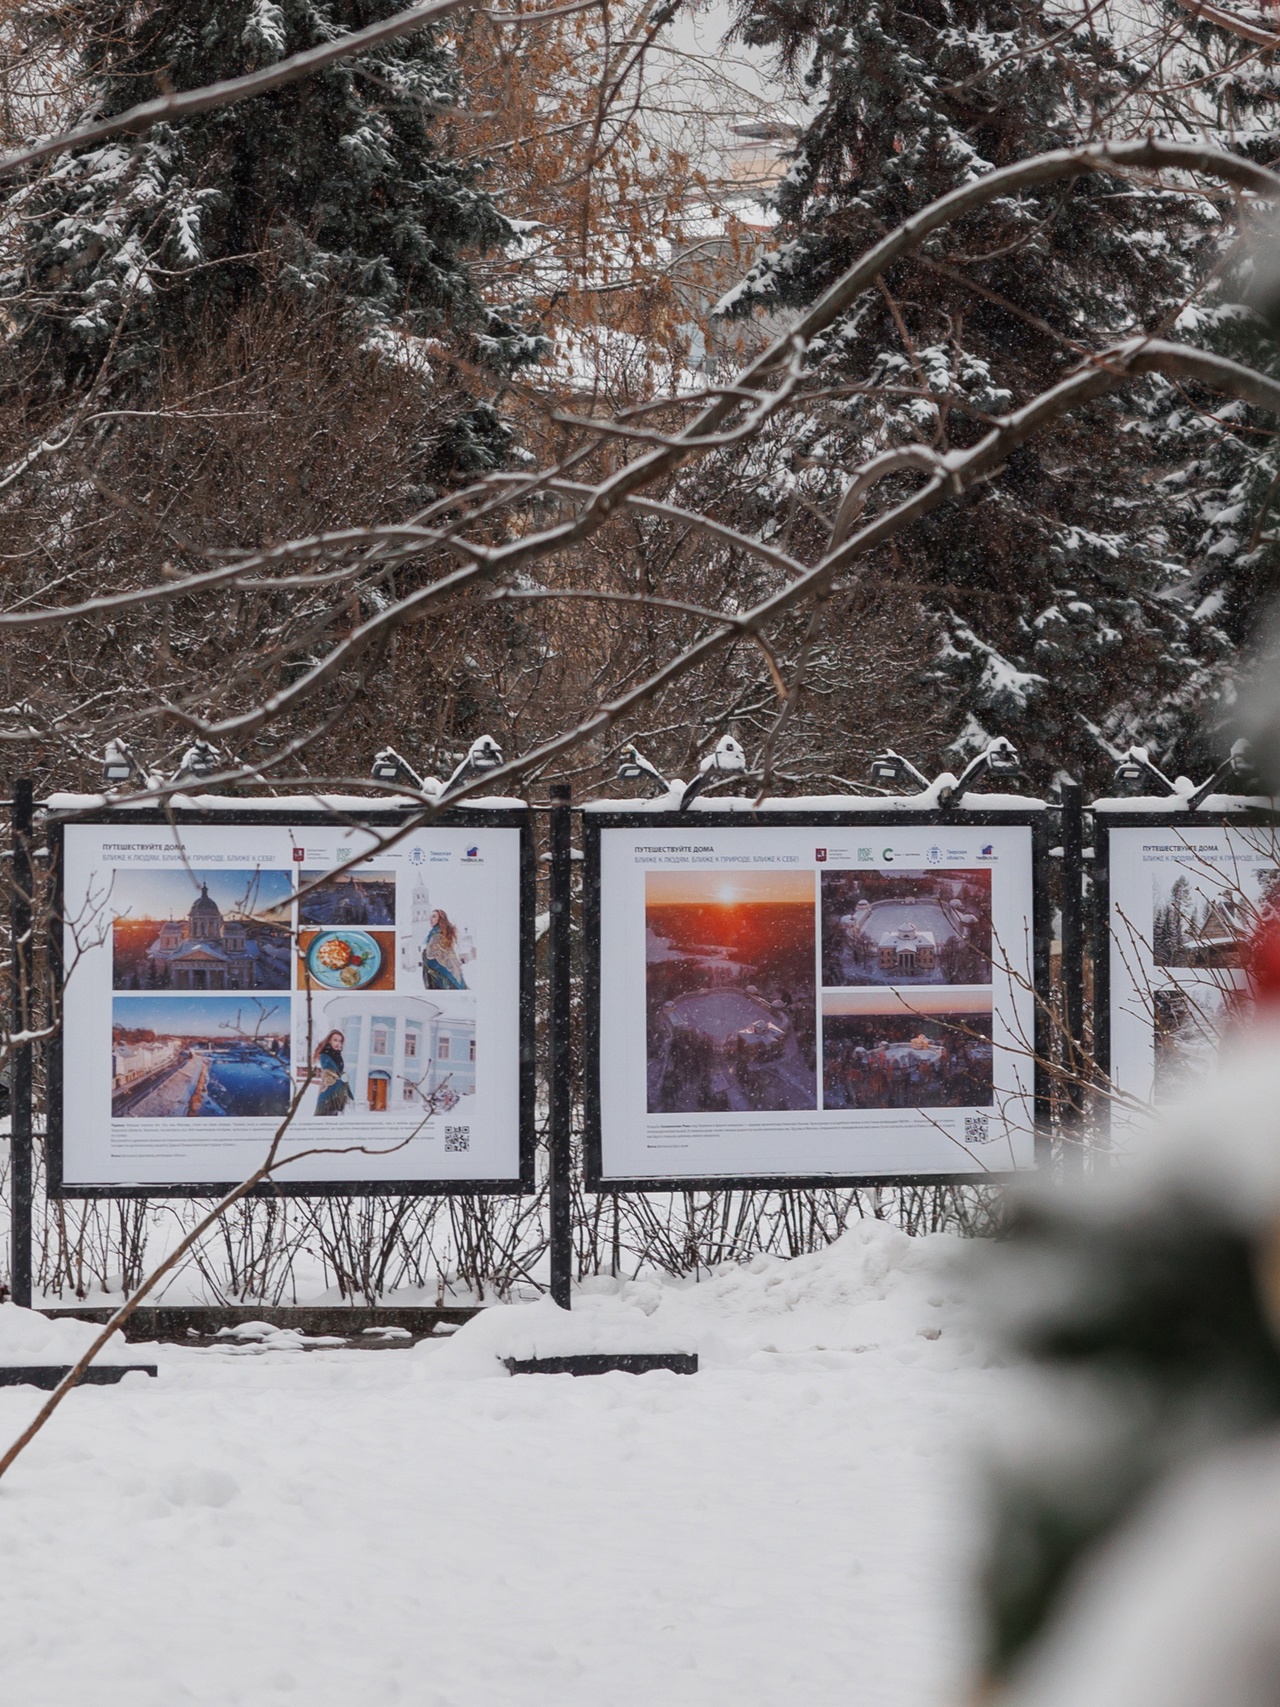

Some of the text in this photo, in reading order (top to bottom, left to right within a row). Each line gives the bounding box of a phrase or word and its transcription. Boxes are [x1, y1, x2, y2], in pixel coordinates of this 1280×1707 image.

[102, 843, 163, 851] ПУТЕШЕСТВУЙТЕ
[634, 845, 692, 853] ПУТЕШЕСТВУЙТЕ
[227, 854, 251, 862] БЛИЖЕ
[752, 855, 776, 863] БЛИЖЕ
